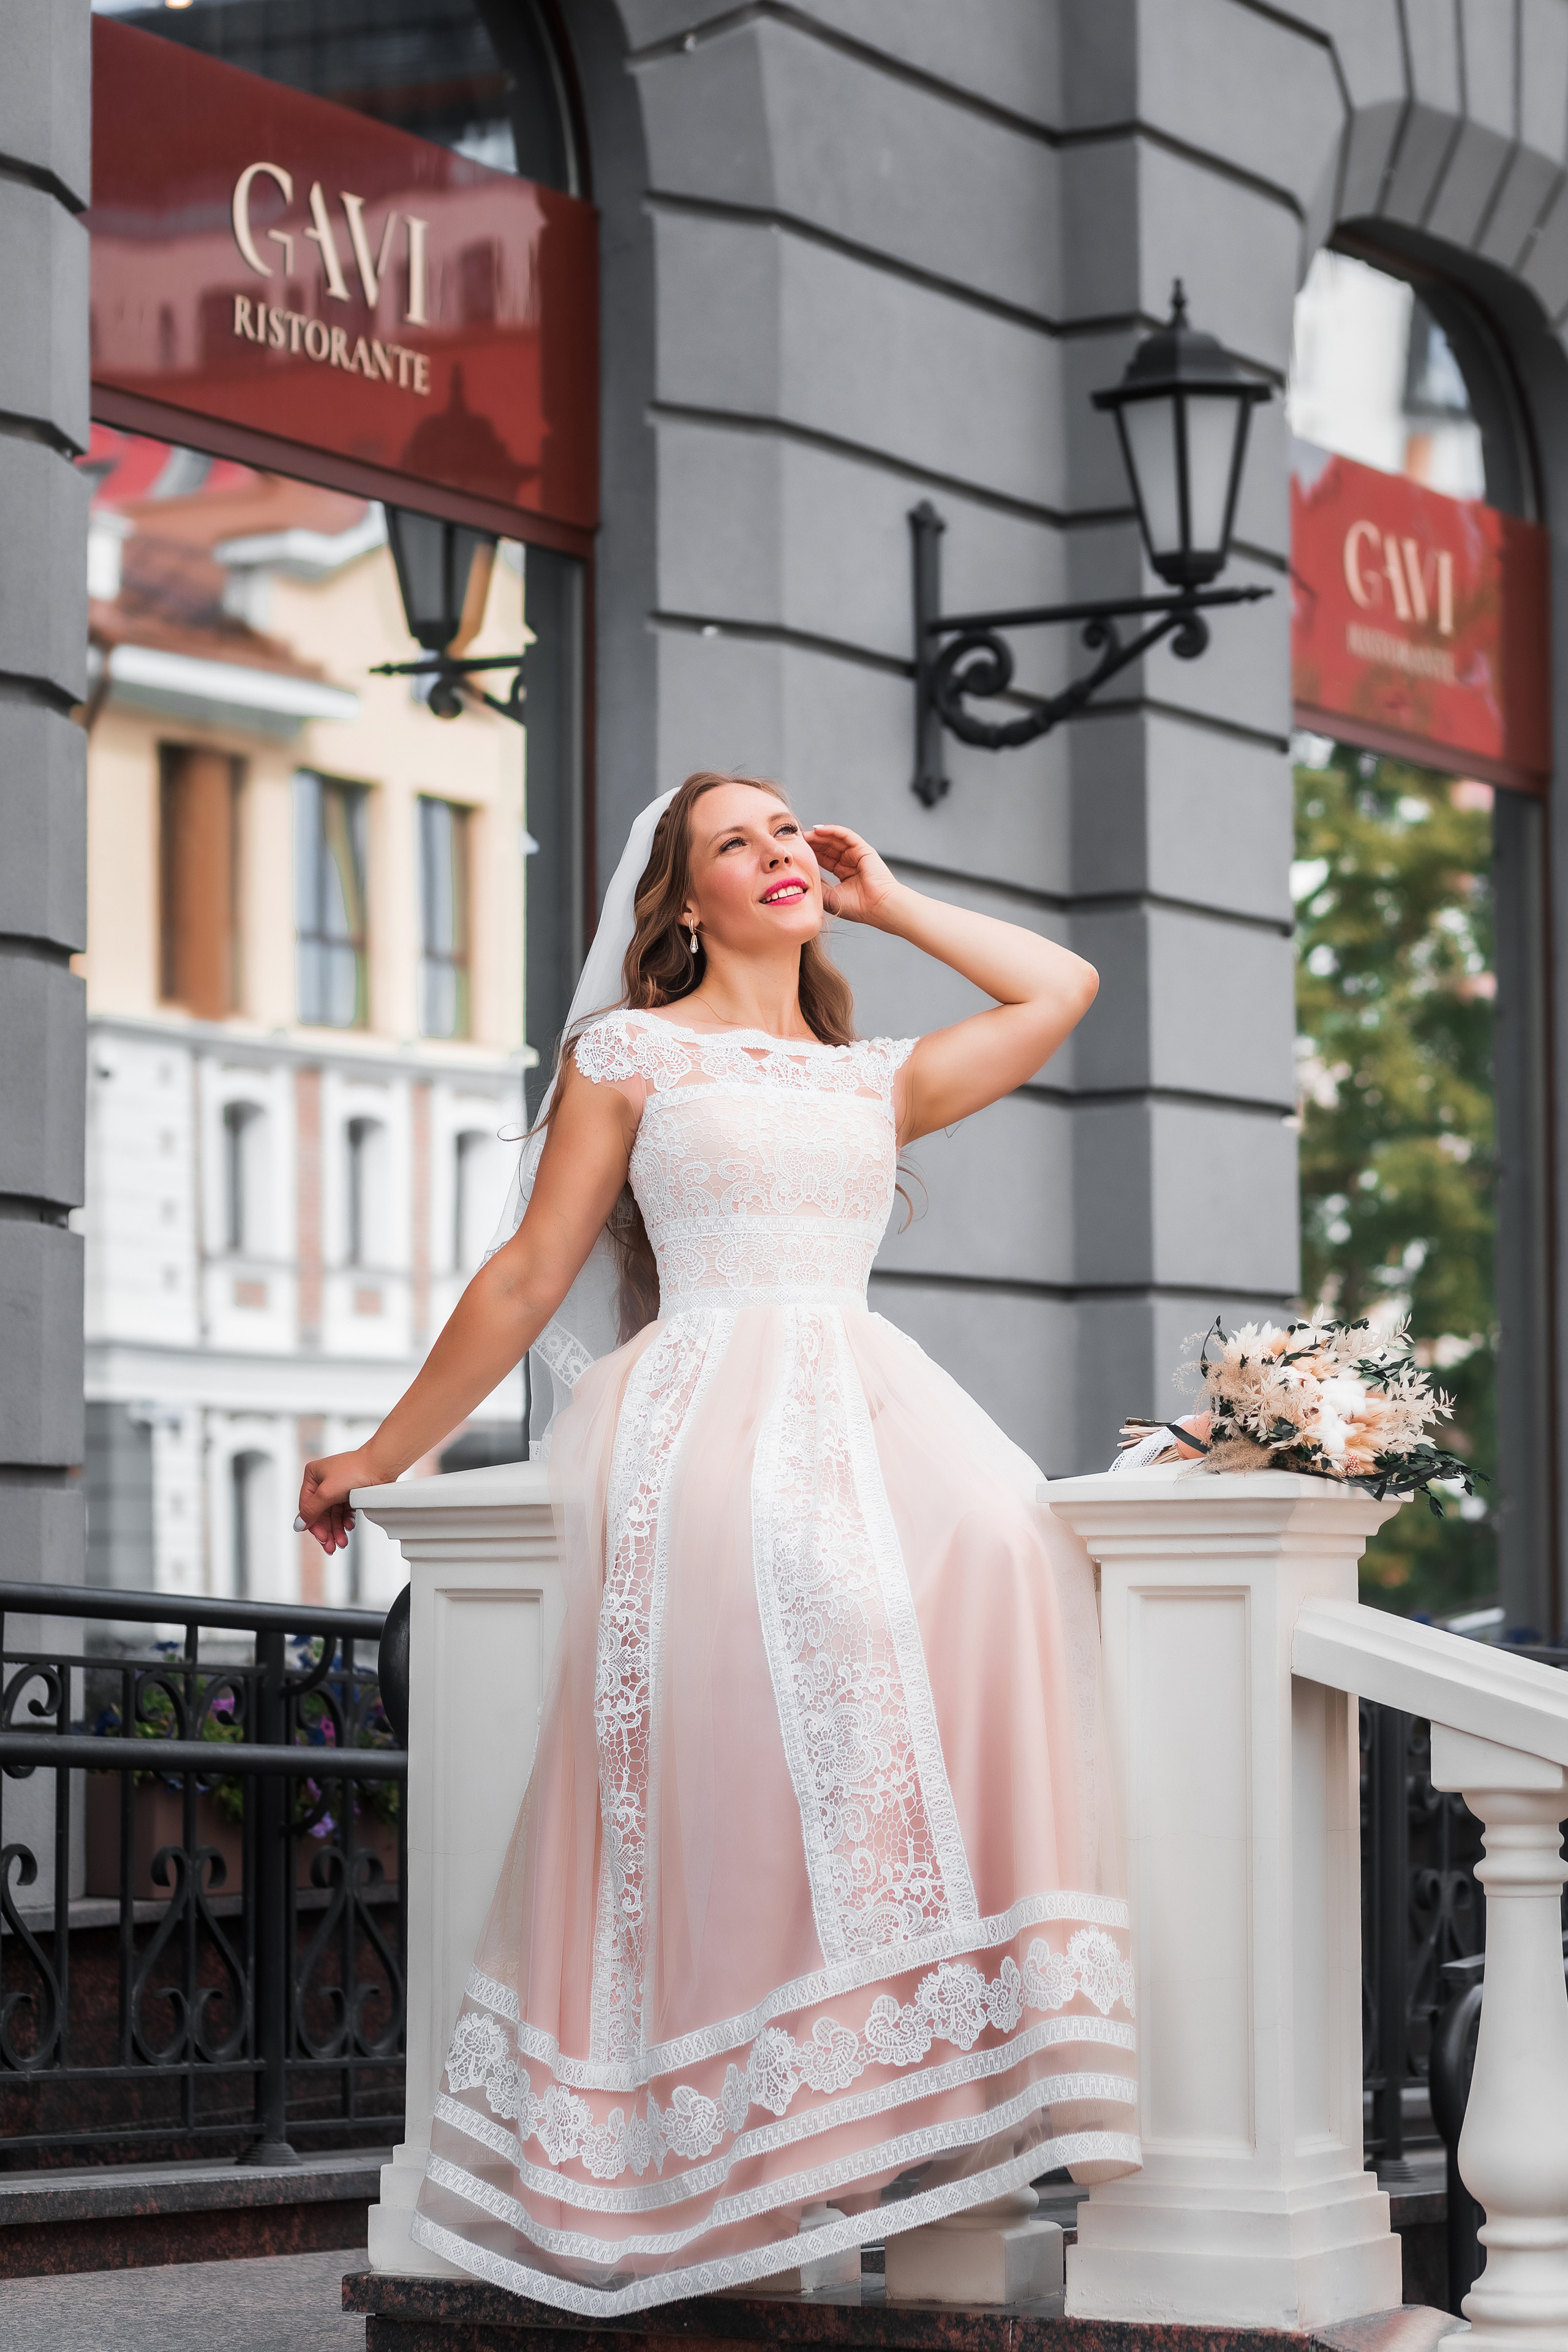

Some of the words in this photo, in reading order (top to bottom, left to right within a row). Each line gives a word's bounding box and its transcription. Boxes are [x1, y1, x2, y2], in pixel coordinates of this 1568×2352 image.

[233, 162, 429, 327] GAVI
[234, 293, 431, 396] RISTORANTE
[1344, 519, 1453, 636] GAVI
